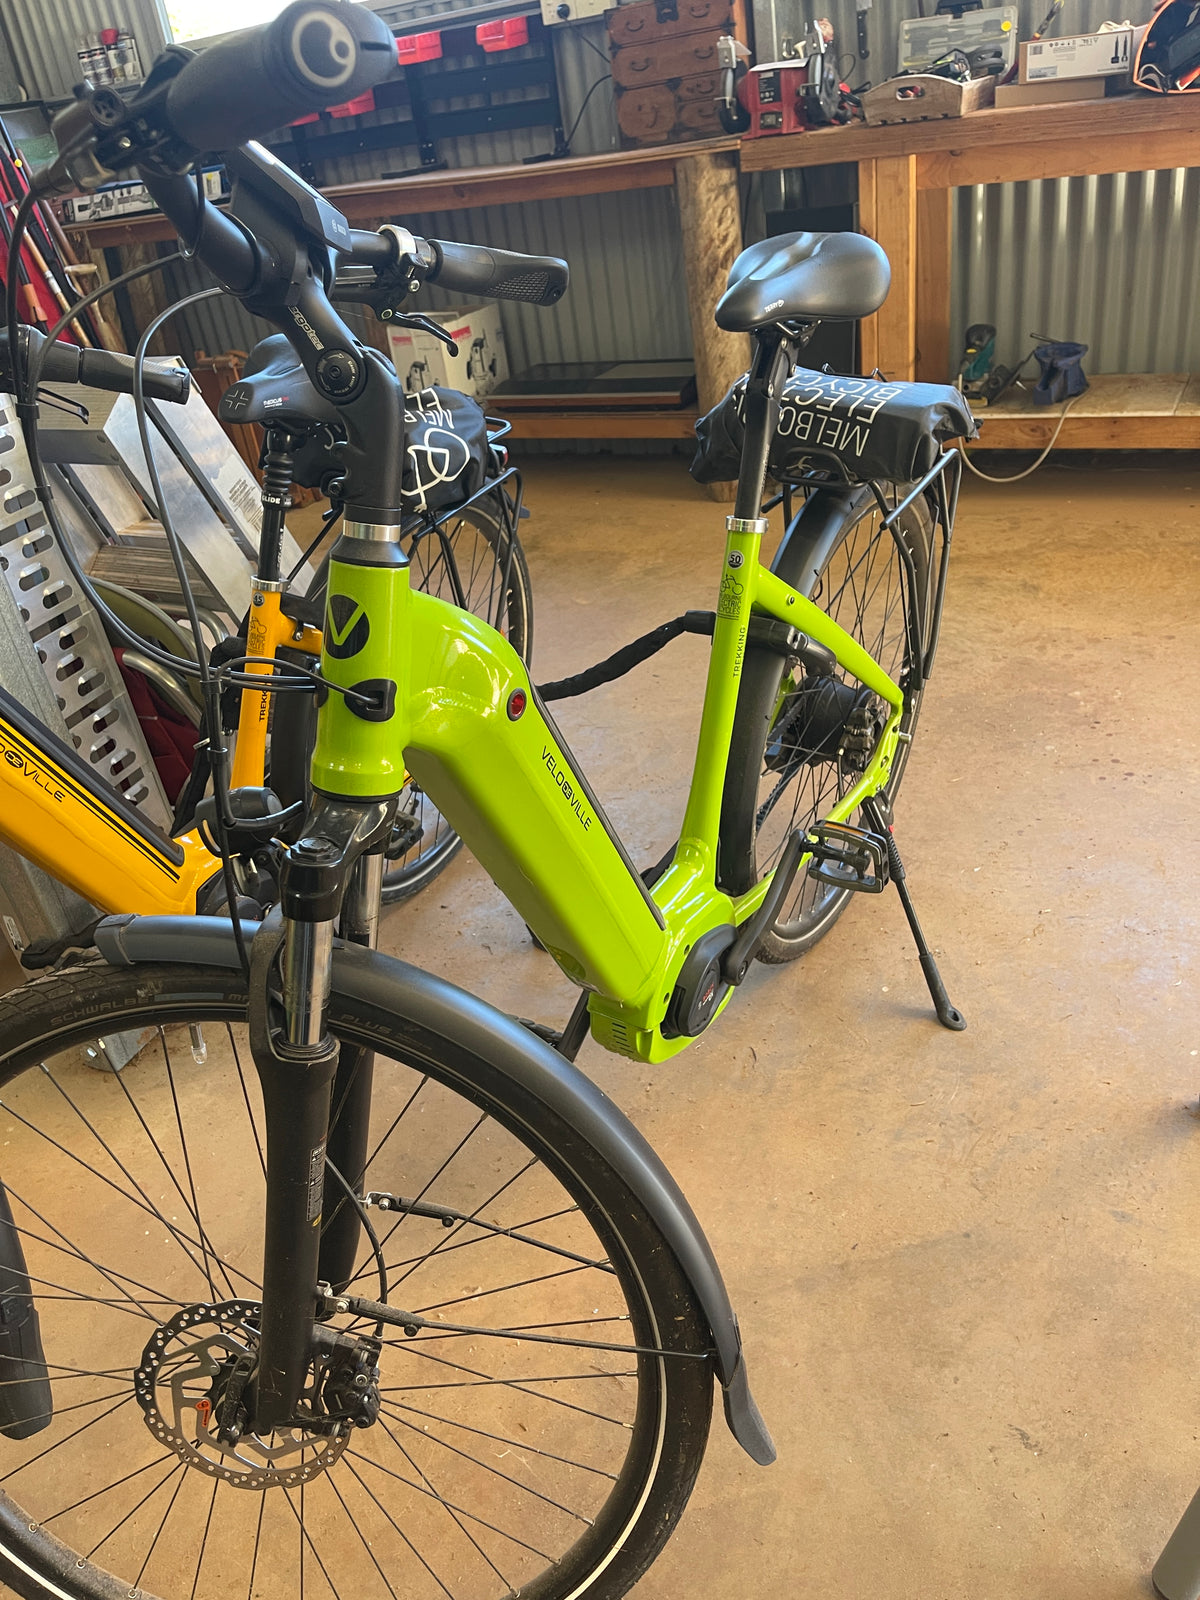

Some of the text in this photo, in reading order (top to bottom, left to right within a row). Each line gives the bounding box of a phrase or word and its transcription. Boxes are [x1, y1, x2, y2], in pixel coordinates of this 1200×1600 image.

[287, 306, 325, 352] ergotec
[777, 406, 871, 458] MELBO
[729, 554, 742, 565] 50
[733, 625, 747, 679] TREKKING
[50, 998, 151, 1026] SCHWALBE
[341, 1013, 393, 1035] PLUS
